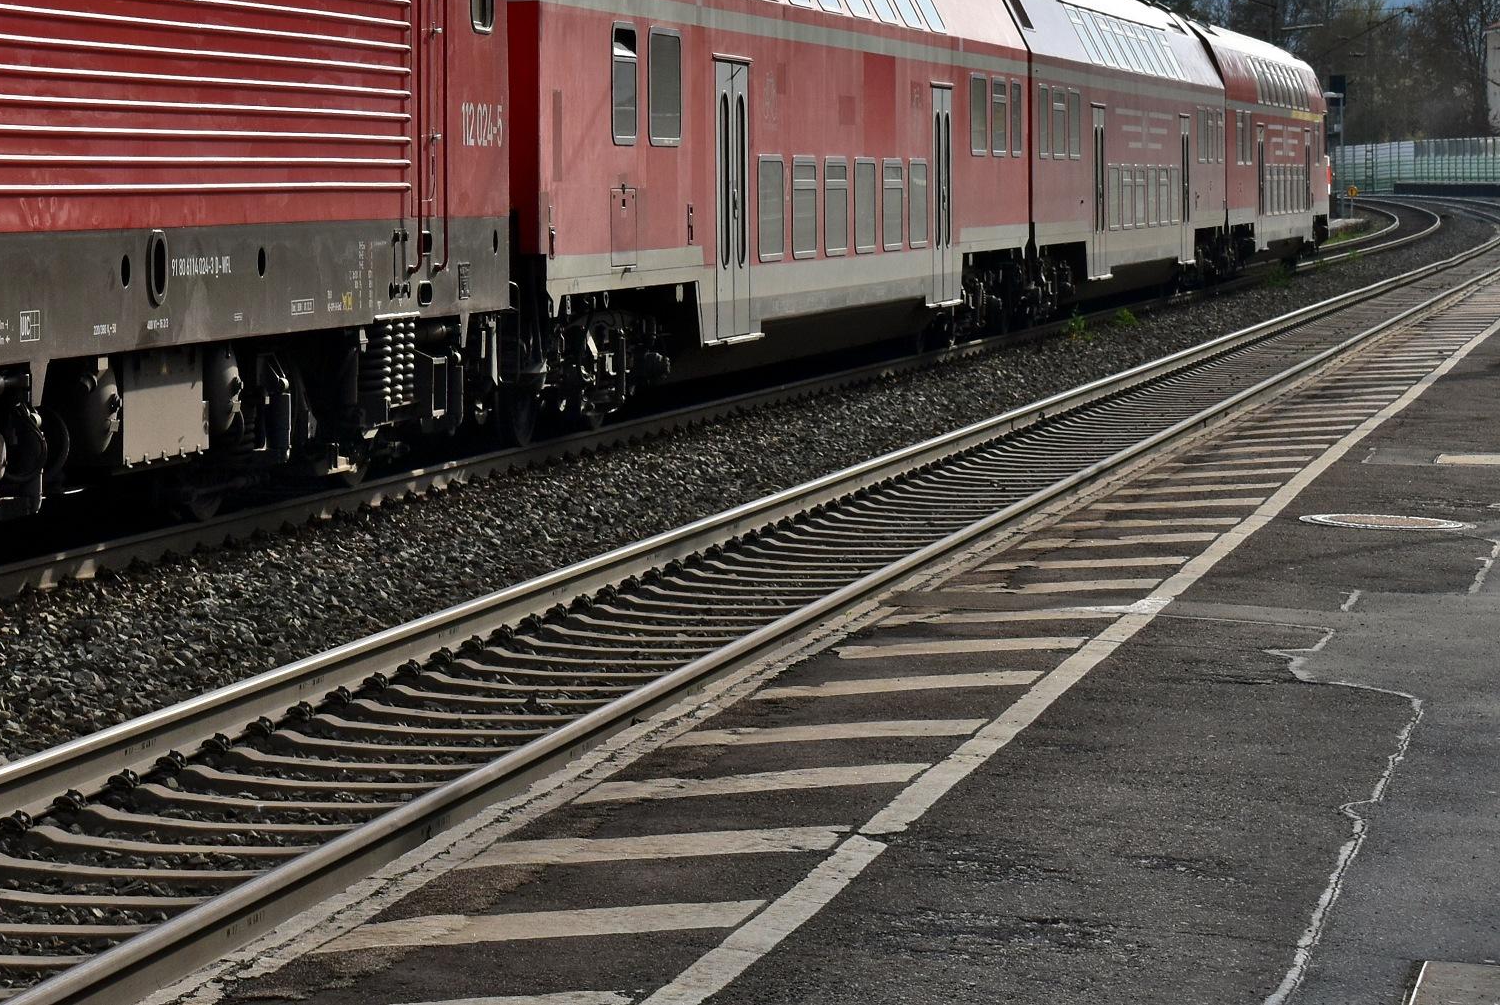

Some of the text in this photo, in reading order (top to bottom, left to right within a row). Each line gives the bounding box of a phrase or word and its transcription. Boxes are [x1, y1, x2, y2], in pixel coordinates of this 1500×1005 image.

[461, 102, 503, 147] 112 024-5
[171, 258, 178, 276] 91
